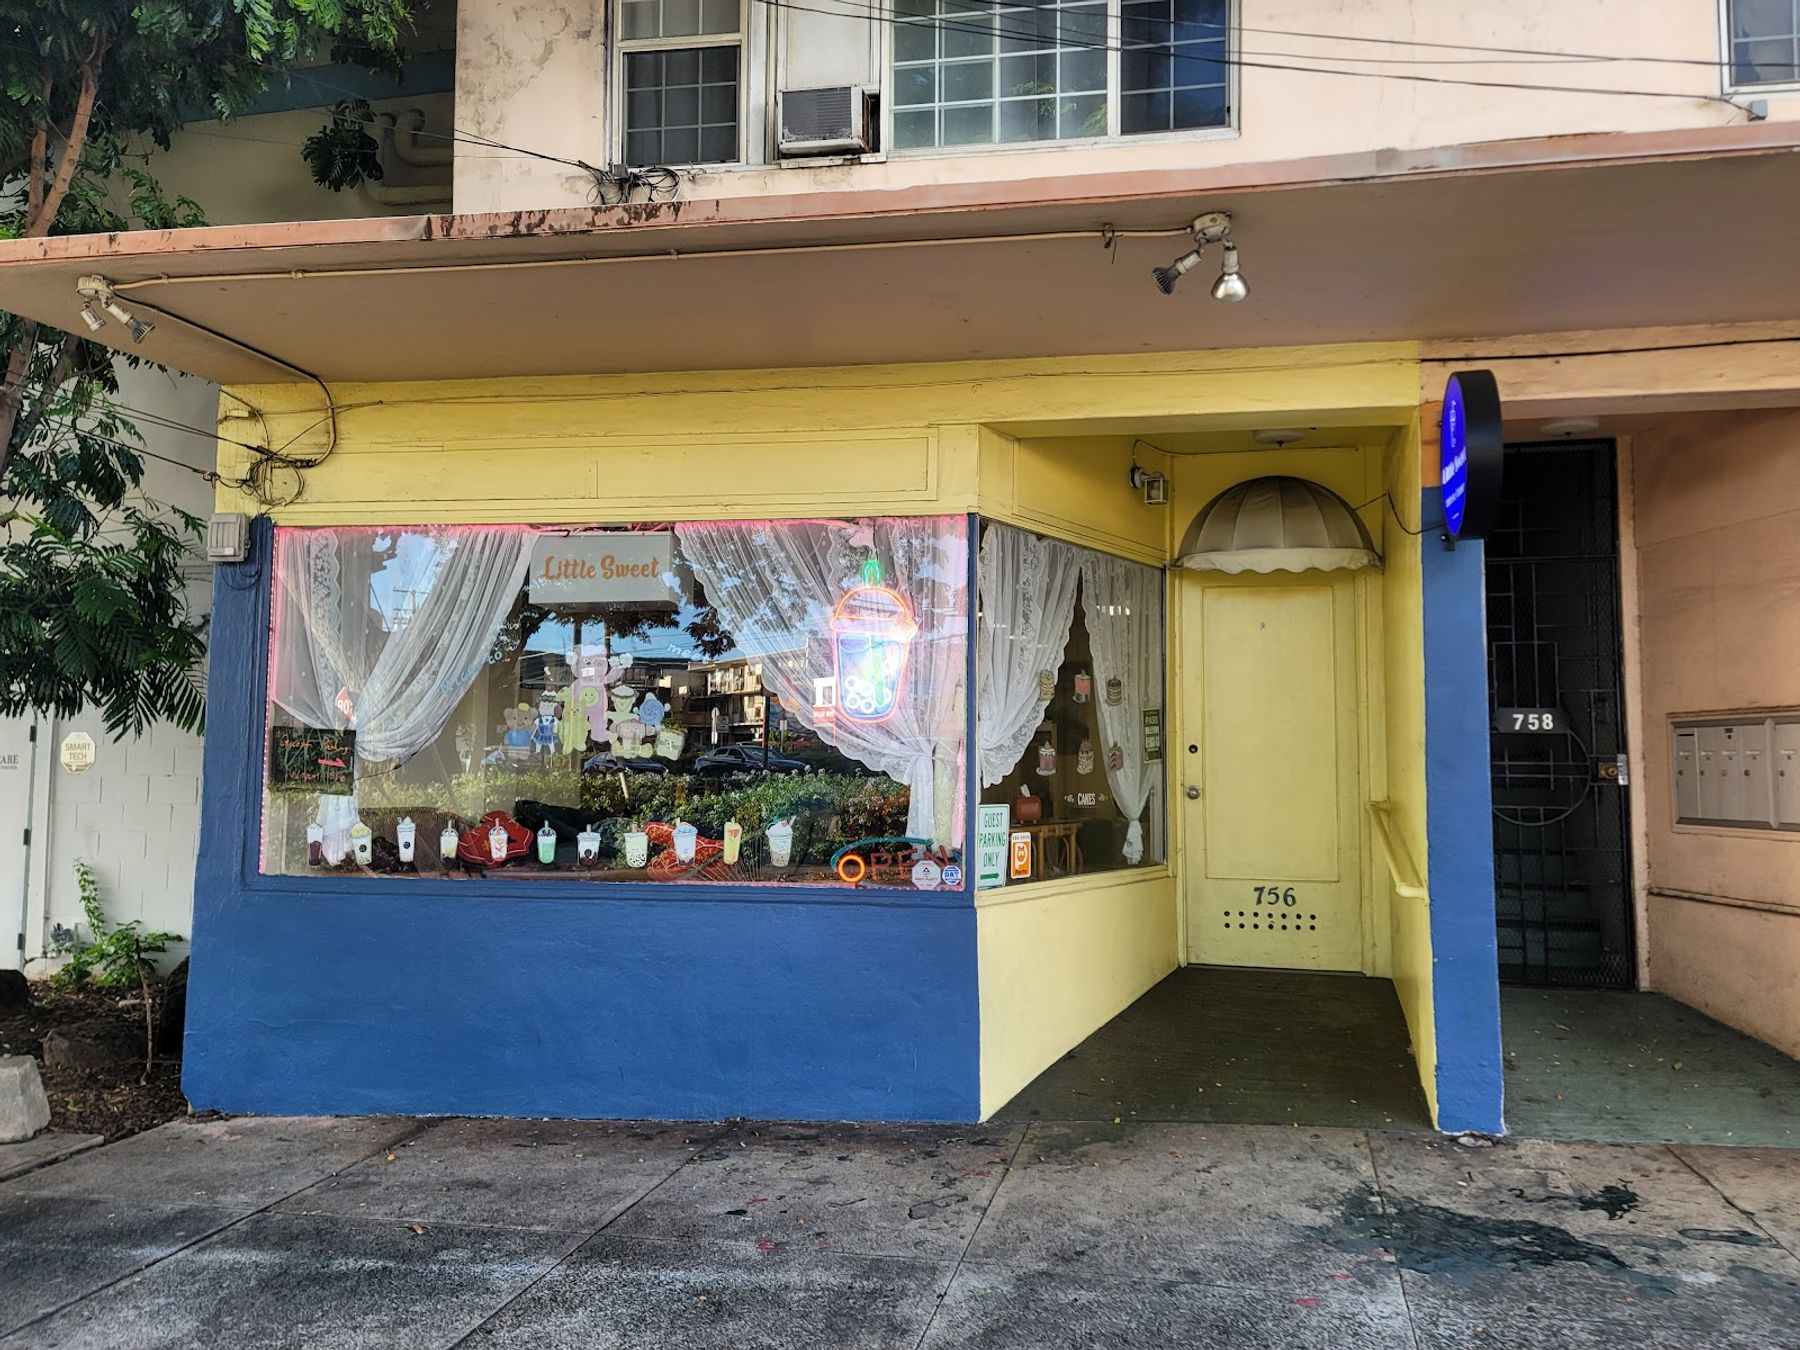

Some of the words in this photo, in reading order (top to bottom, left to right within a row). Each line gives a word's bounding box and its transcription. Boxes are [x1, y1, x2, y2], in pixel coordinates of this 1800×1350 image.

[539, 555, 597, 581] Little
[600, 554, 660, 580] Sweet
[1512, 713, 1554, 730] 758
[65, 743, 91, 752] SMART
[0, 754, 19, 764] ARE
[68, 753, 87, 761] TECH
[1077, 793, 1096, 806] CAKES
[984, 813, 1003, 828] GUEST
[979, 832, 1005, 848] PARKING
[983, 852, 999, 868] ONLY
[1253, 886, 1297, 907] 756
